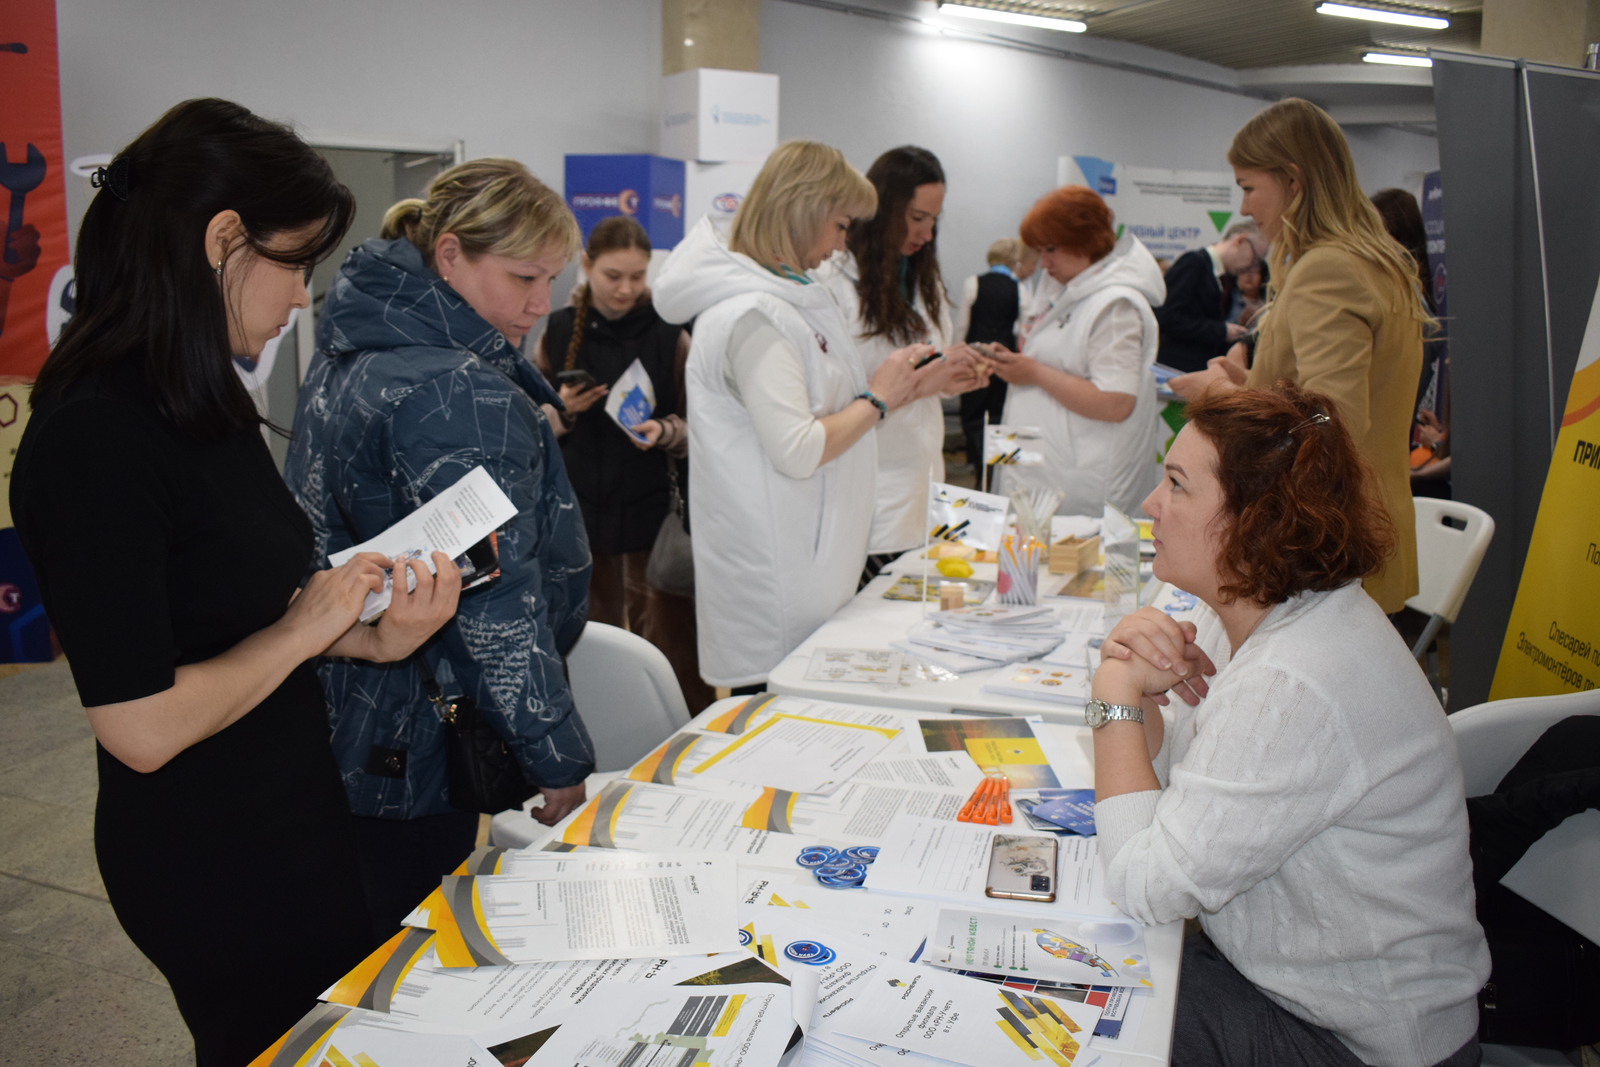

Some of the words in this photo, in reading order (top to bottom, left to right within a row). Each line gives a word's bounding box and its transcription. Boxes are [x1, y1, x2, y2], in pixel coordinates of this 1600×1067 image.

[1573, 440, 1600, 470] ПРИ
[1549, 621, 1591, 660] Слесарей
[1517, 631, 1583, 689] Электромонтёров
[895, 1013, 919, 1039] Открытые
[915, 988, 935, 1014] вакансии
[916, 1005, 938, 1030] филиала
[947, 1011, 960, 1025] Уфе
[923, 1026, 937, 1039] ООО
[739, 1042, 751, 1056] ООО
